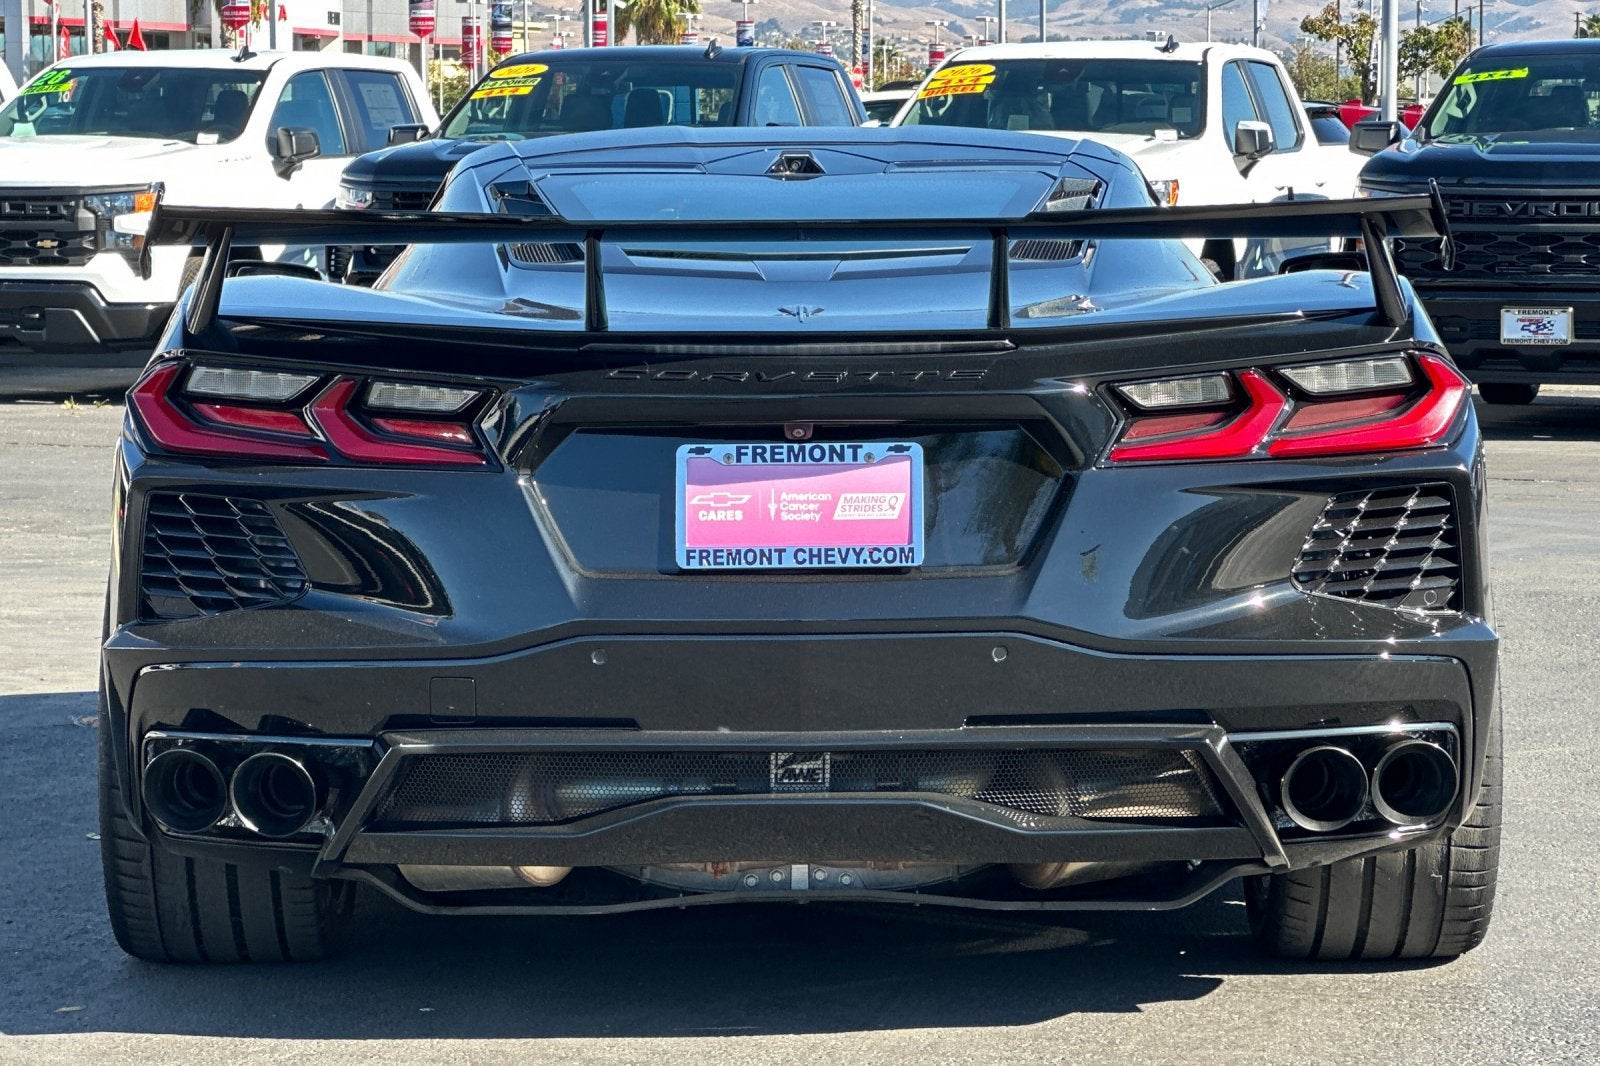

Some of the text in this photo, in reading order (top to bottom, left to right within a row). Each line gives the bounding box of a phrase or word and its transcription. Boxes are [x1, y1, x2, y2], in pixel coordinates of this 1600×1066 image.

[501, 78, 539, 87] POWER
[924, 85, 977, 97] DIESEL
[604, 369, 988, 383] CORVETTE
[735, 444, 863, 464] FREMONT
[780, 491, 832, 501] American
[843, 495, 887, 504] MAKING
[780, 501, 820, 511] Cancer
[840, 504, 884, 513] STRIDES
[698, 510, 744, 522] CARES
[780, 511, 821, 522] Society
[685, 546, 915, 566] FREMONT CHEVY.COM
